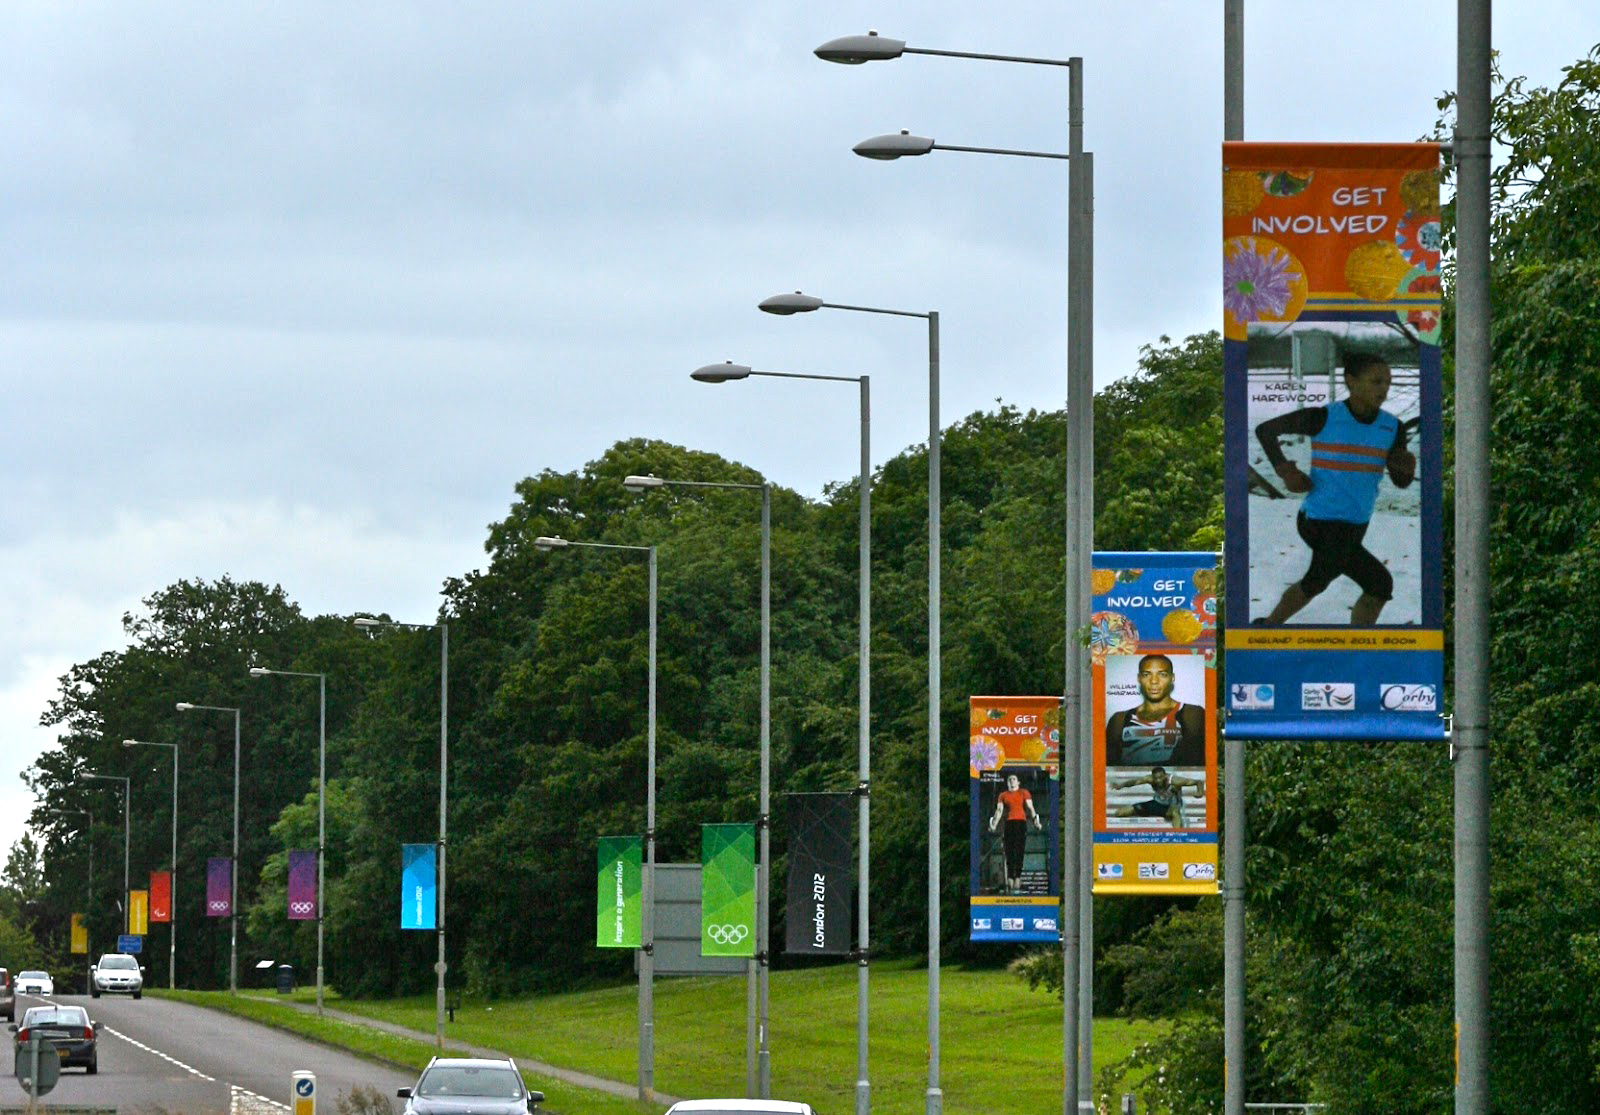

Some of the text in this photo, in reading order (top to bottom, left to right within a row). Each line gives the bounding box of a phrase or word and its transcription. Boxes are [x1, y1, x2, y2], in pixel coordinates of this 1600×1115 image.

[1332, 187, 1387, 206] GET
[1252, 215, 1388, 234] INVOLVED
[1265, 383, 1307, 391] KAREN
[1252, 394, 1326, 403] HAREWOOD
[1153, 580, 1186, 591] GET
[1107, 596, 1186, 608] INVOLVED
[1247, 637, 1292, 645] ENGLAND
[1297, 637, 1345, 645] CHAMPION
[1350, 637, 1377, 645] 2011
[1380, 684, 1436, 711] Corby
[1014, 715, 1038, 724] GET
[982, 726, 1038, 735] INVOLVED
[1183, 864, 1214, 878] Corby
[614, 861, 625, 908] generation
[812, 873, 825, 948] London 2012
[614, 915, 624, 944] Inspire
